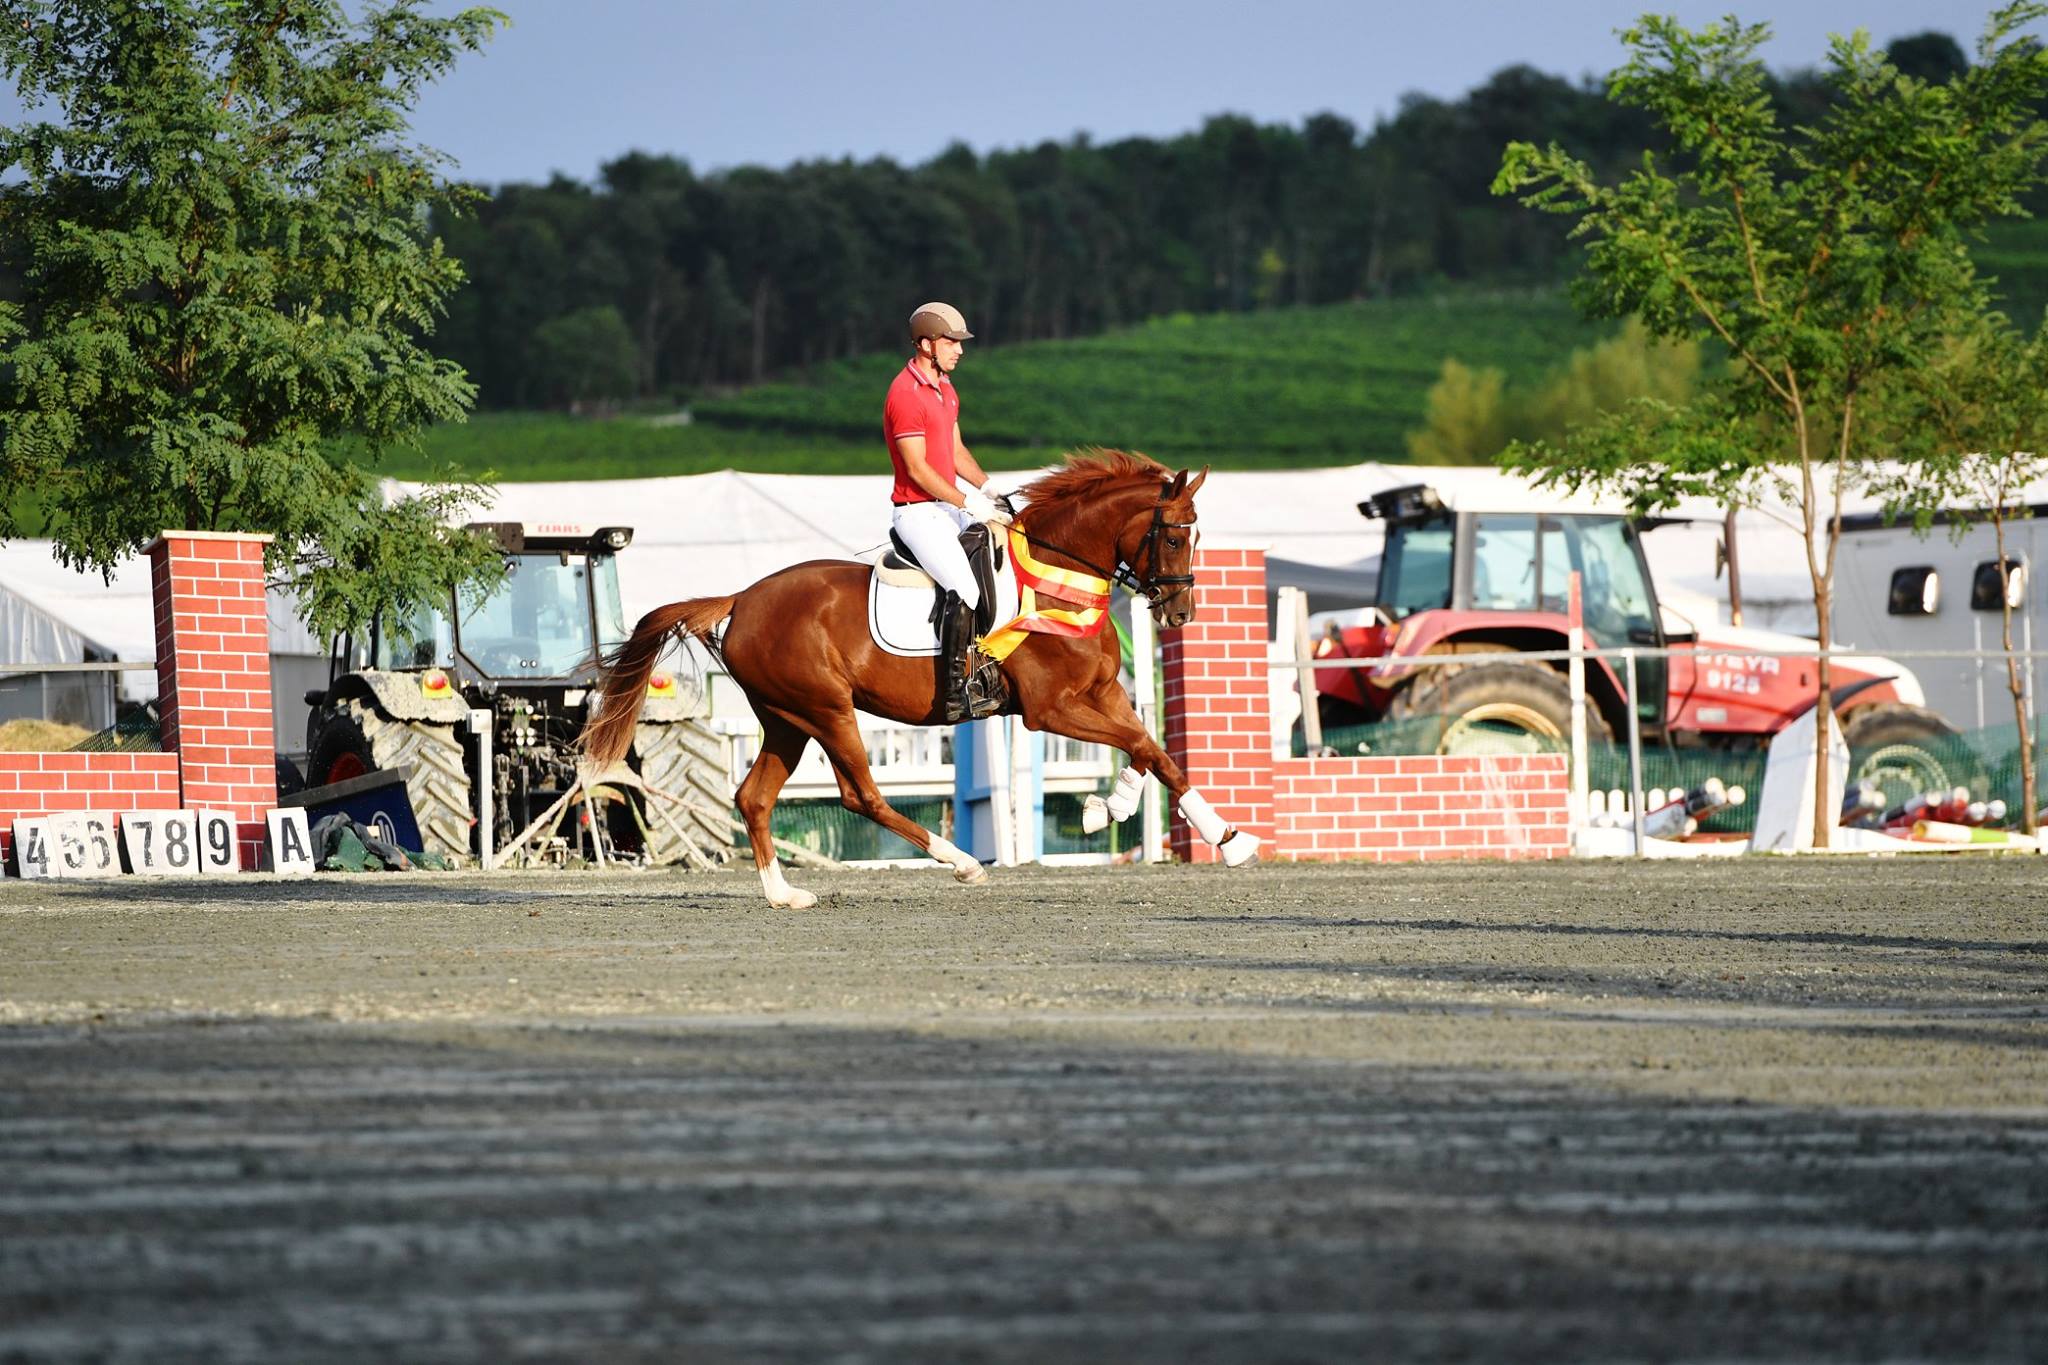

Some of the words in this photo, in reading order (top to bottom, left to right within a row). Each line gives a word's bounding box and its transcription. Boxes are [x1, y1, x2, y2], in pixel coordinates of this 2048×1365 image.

[26, 827, 50, 874] 4
[60, 820, 87, 869] 5
[87, 820, 110, 869] 6
[131, 820, 154, 868] 7
[165, 819, 190, 868] 8
[208, 818, 231, 866] 9
[281, 816, 310, 863] A
